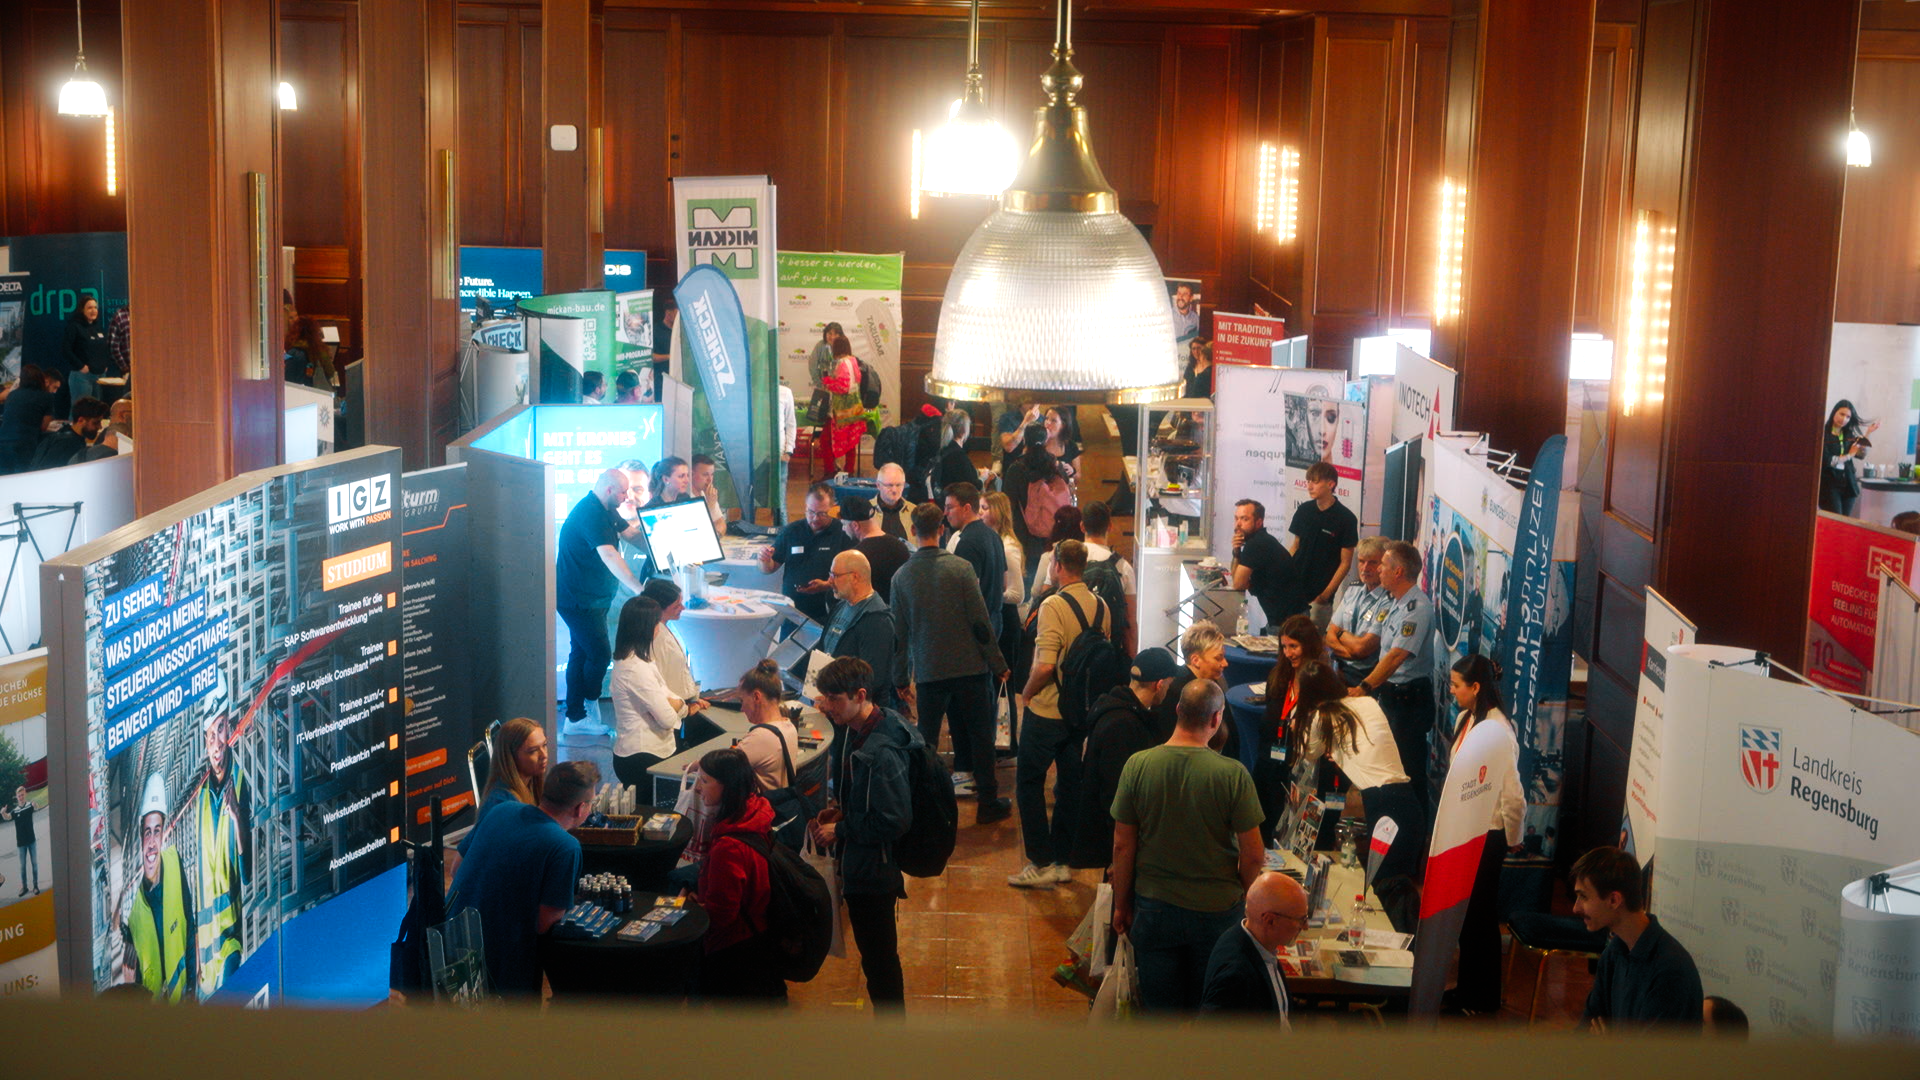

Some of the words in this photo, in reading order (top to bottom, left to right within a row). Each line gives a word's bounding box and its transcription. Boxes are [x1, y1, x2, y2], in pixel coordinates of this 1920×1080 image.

[788, 259, 820, 267] besser
[837, 260, 882, 270] werden,
[464, 276, 494, 286] Future.
[780, 272, 800, 281] auf
[802, 273, 817, 286] gut
[460, 288, 497, 299] ncredible
[547, 304, 606, 315] mickan-bau.de
[1218, 321, 1232, 331] MIT
[1234, 323, 1273, 336] TRADITION
[1218, 333, 1226, 342] IN
[1227, 335, 1240, 344] DIE
[1399, 381, 1431, 423] INOTECH
[543, 432, 574, 447] MIT
[577, 431, 637, 446] KRONES
[543, 450, 583, 465] GEHT
[585, 450, 603, 465] ES
[555, 469, 575, 484] IR
[335, 479, 389, 518] IGZ
[329, 521, 349, 535] WORK
[350, 517, 365, 530] WITH
[366, 510, 392, 525] PASSION
[405, 504, 438, 518] GRUPPE
[328, 551, 388, 583] STUDIUM
[1832, 580, 1868, 600] ENTDECKE
[105, 600, 121, 629] ZU
[123, 581, 162, 619] SEHEN,
[338, 600, 362, 615] Trainee
[363, 596, 373, 607] für
[373, 593, 383, 604] die
[1833, 598, 1863, 616] FEELING
[106, 636, 131, 669] WAS
[134, 613, 171, 654] DURCH
[173, 595, 204, 631] MEINE
[284, 633, 300, 648] SAP
[300, 613, 368, 642] Softwareentwicklung
[361, 642, 384, 657] Trainee
[107, 618, 229, 710] STEUERUNGSSOFTWARE
[290, 682, 306, 697] SAP
[307, 673, 334, 691] Logistik
[334, 660, 369, 681] Consultant
[340, 698, 363, 713] Trainee
[364, 688, 385, 704] zum/-r
[1524, 634, 1542, 749] FEDERAL
[108, 701, 154, 751] BEWEGT
[156, 685, 182, 719] WIRD
[191, 662, 217, 697] IRRE!
[331, 749, 371, 773] Praktikant:in
[1793, 747, 1863, 796] Landkreis
[1460, 782, 1492, 801] REGENSBURG
[1461, 778, 1477, 792] STADT
[323, 796, 371, 825] Werkstudent:in
[1790, 776, 1879, 841] Regensburg
[329, 837, 387, 871] Abschlussarbeiten
[1848, 958, 1920, 982] Regensbur
[4, 974, 39, 997] UNS:
